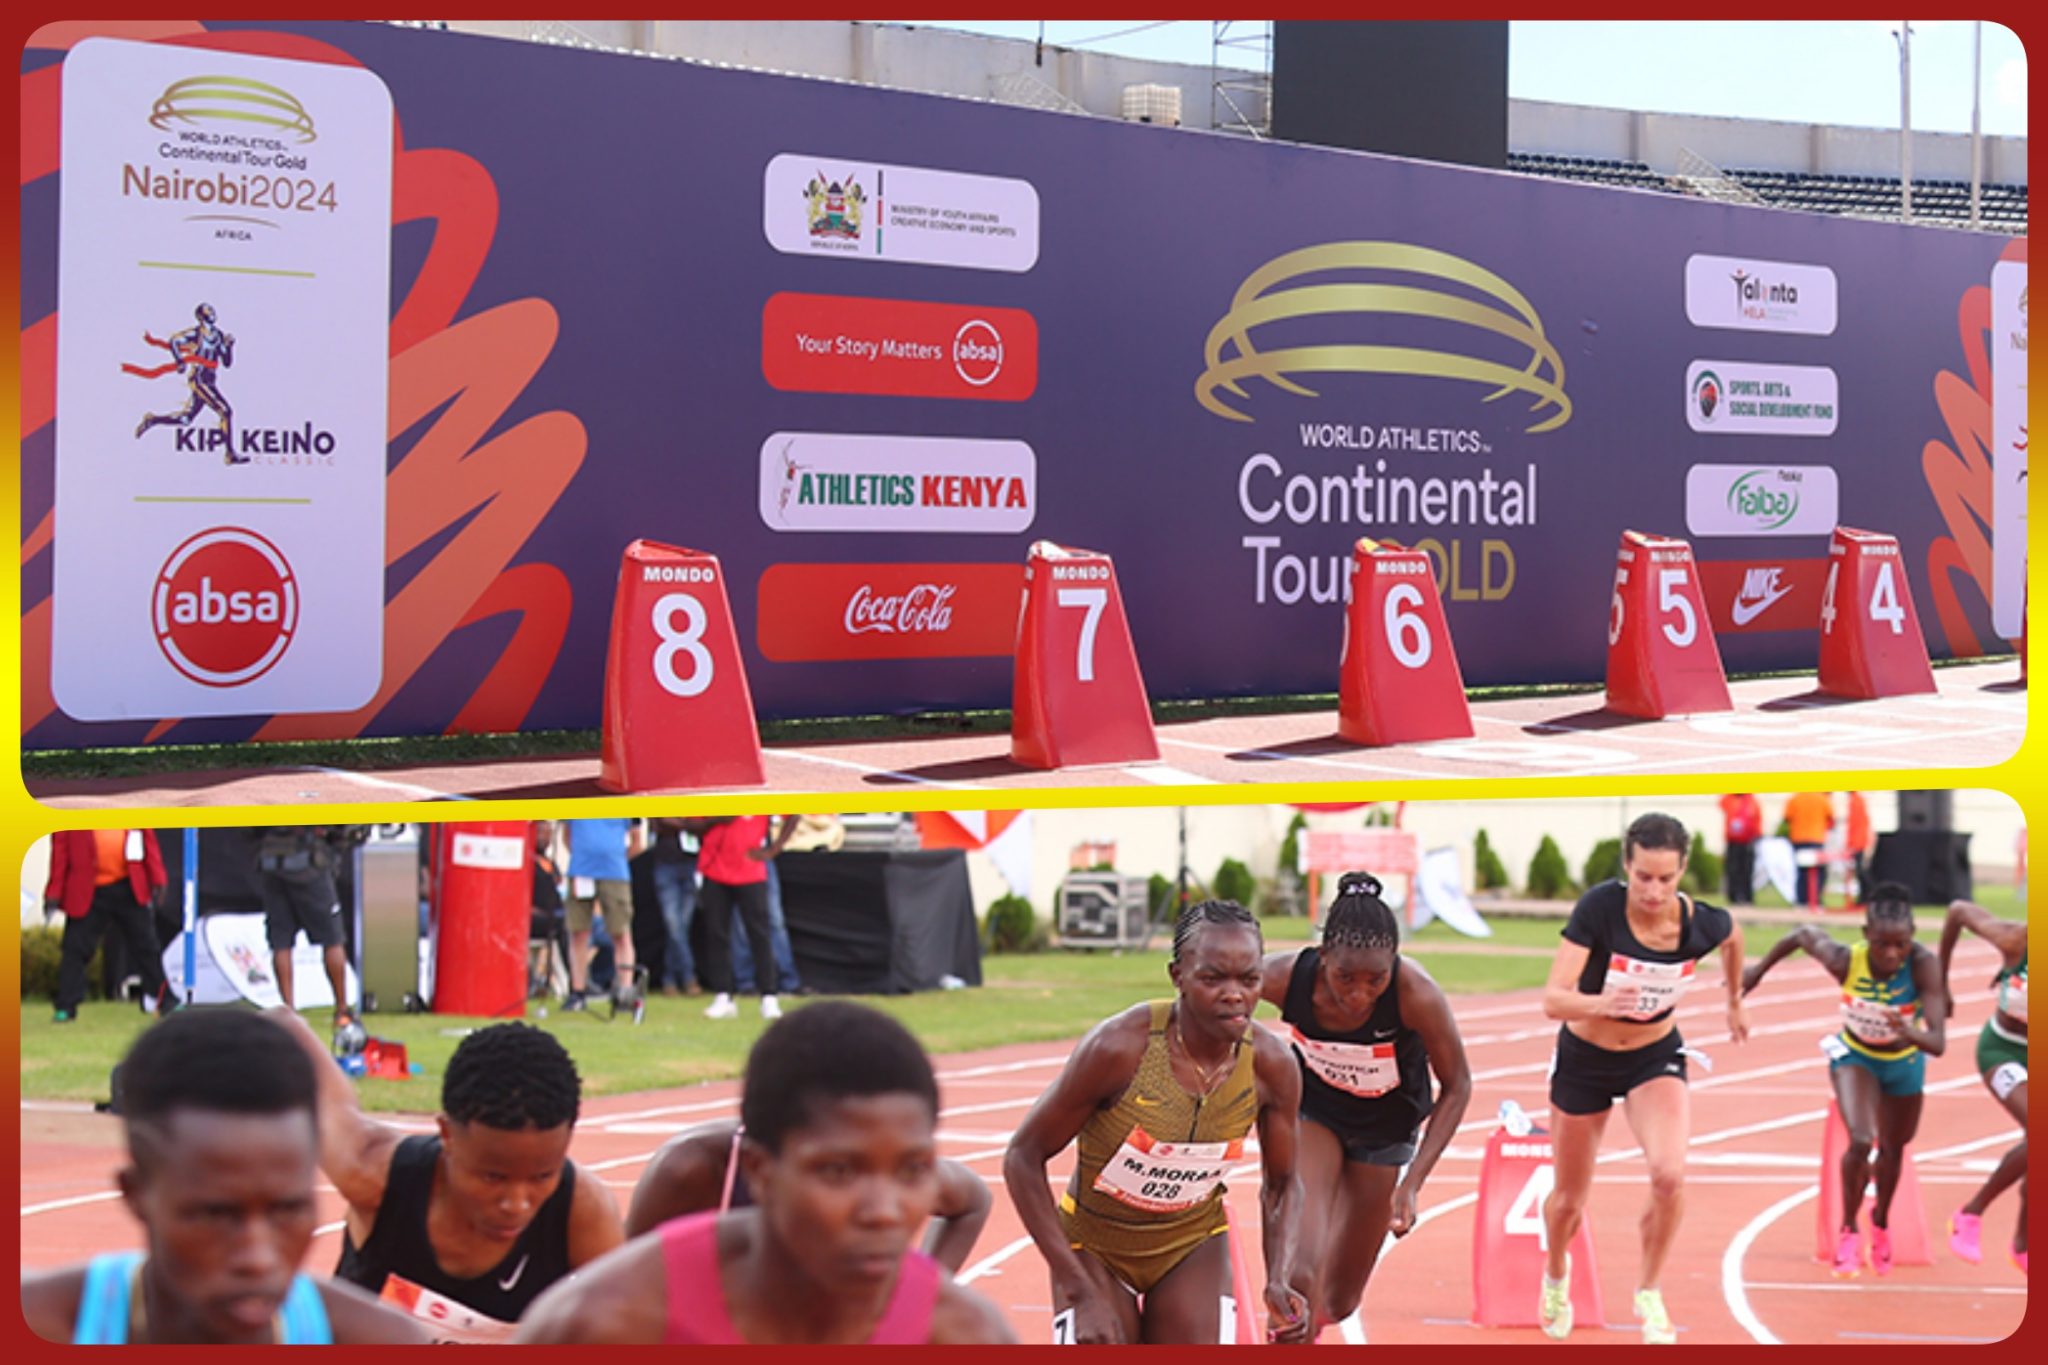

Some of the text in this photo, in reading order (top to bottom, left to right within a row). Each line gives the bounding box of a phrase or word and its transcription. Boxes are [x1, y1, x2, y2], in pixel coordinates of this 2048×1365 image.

[179, 131, 282, 151] WORLD ATHLETICS
[159, 142, 307, 171] Continental Tour Gold
[891, 204, 928, 215] MINISTRY
[214, 229, 252, 241] AFRICA
[986, 226, 1017, 238] SPORTS
[796, 334, 943, 360] Your Story Matters
[959, 339, 998, 360] absa
[176, 421, 336, 455] KIP KEINO
[1299, 423, 1482, 453] WORLD ATHLETICS
[254, 456, 336, 466] CLASSIC
[798, 473, 1027, 509] ATHLETICS KENYA
[1238, 453, 1537, 526] Continental
[643, 566, 715, 583] MONDO
[1053, 566, 1110, 580] MONDO
[1376, 561, 1427, 574] MONDO
[1378, 537, 1517, 602] OLD
[172, 576, 280, 624] absa
[1660, 567, 1697, 647] 5
[1869, 561, 1906, 634] 4
[1057, 588, 1108, 682] 7
[1384, 582, 1432, 669] 6
[652, 592, 715, 698] 8
[1141, 1181, 1182, 1200] 028
[1504, 1163, 1556, 1253] 4
